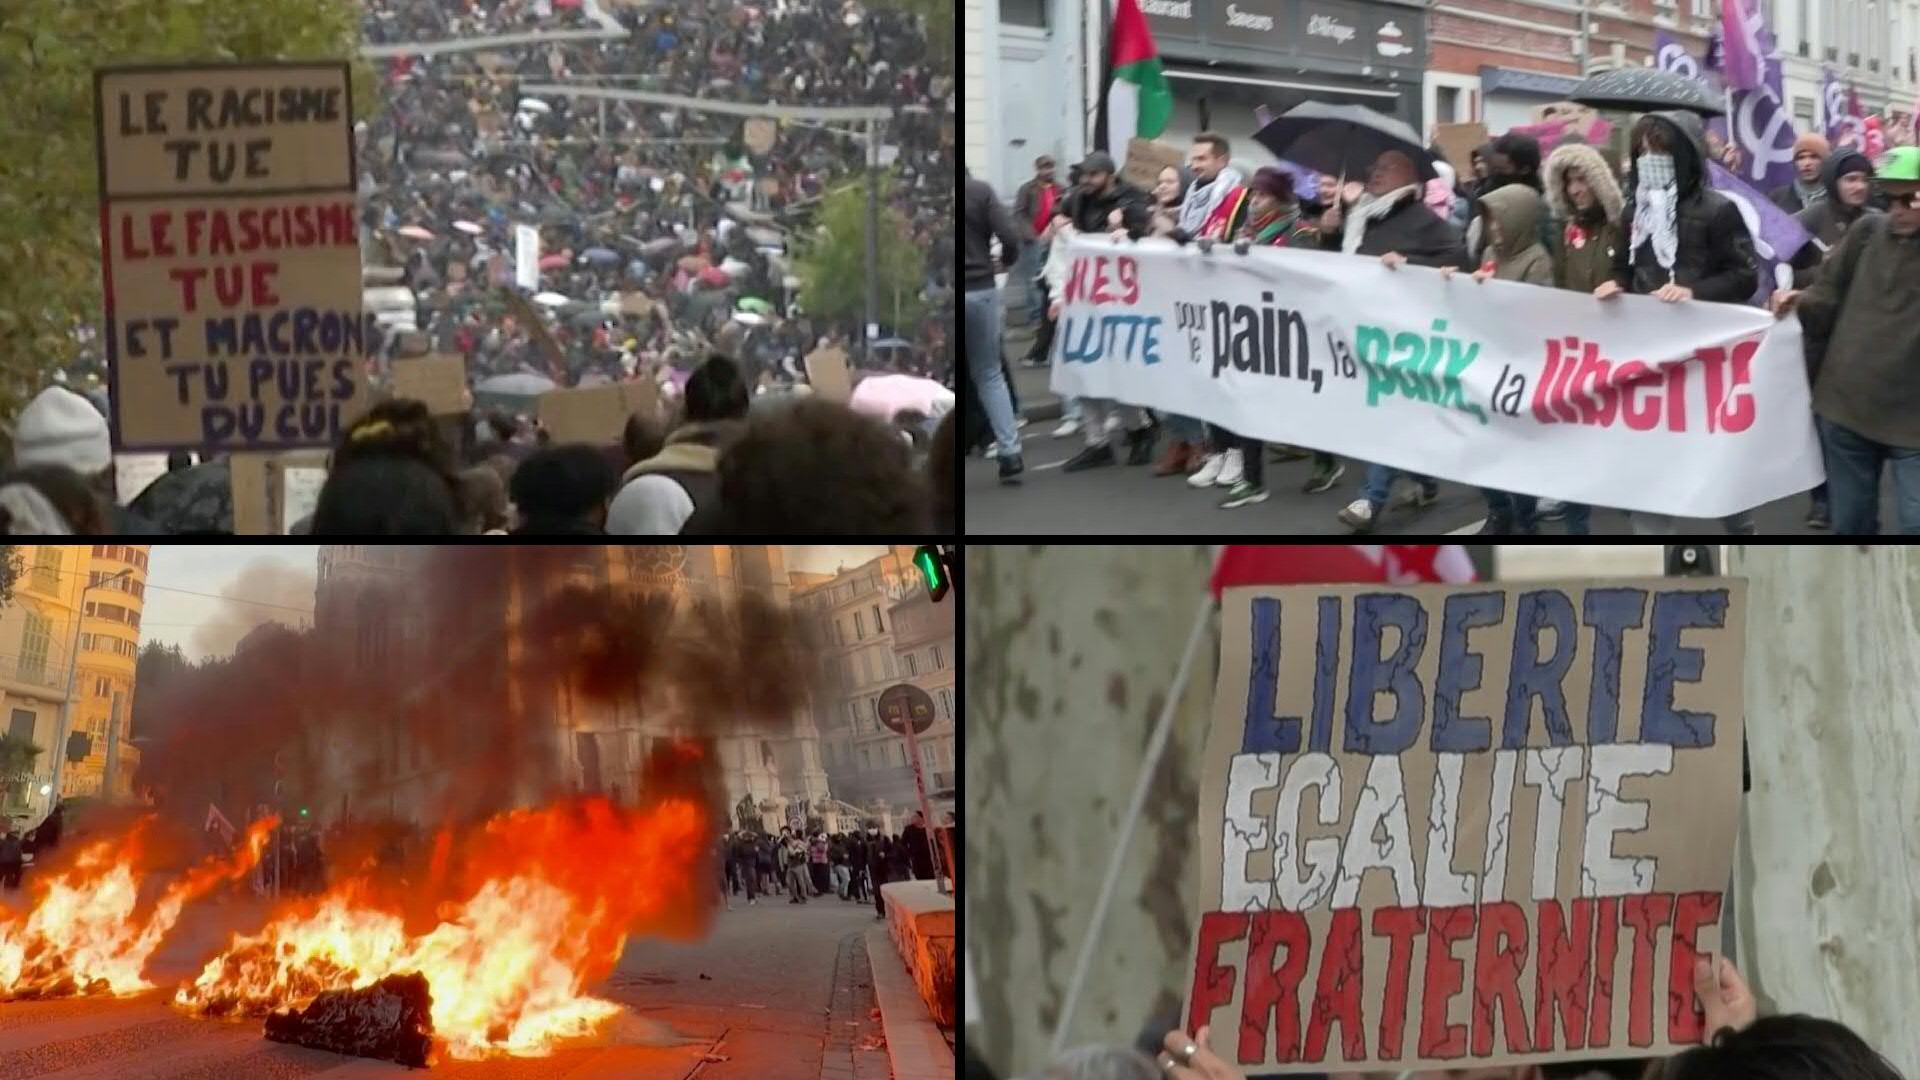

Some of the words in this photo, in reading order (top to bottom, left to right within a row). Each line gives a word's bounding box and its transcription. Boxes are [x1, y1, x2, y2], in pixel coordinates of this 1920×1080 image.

[119, 90, 168, 136] LE
[187, 86, 341, 131] RACISME
[164, 138, 271, 182] TUE
[122, 212, 176, 259] LE
[185, 203, 358, 255] FASCISME
[169, 263, 280, 312] TUE
[126, 318, 179, 359] ET
[206, 308, 362, 355] MACRON
[1210, 291, 1323, 393] pain,
[1327, 332, 1357, 379] la
[165, 361, 228, 405] TU
[250, 360, 354, 401] PUES
[1491, 364, 1526, 416] la
[202, 403, 264, 442] DU
[275, 403, 344, 441] CUL
[1242, 588, 1730, 755] LIBERTE
[1220, 743, 1673, 913] EGALITE
[1188, 892, 1723, 1064] FRATERNITE
